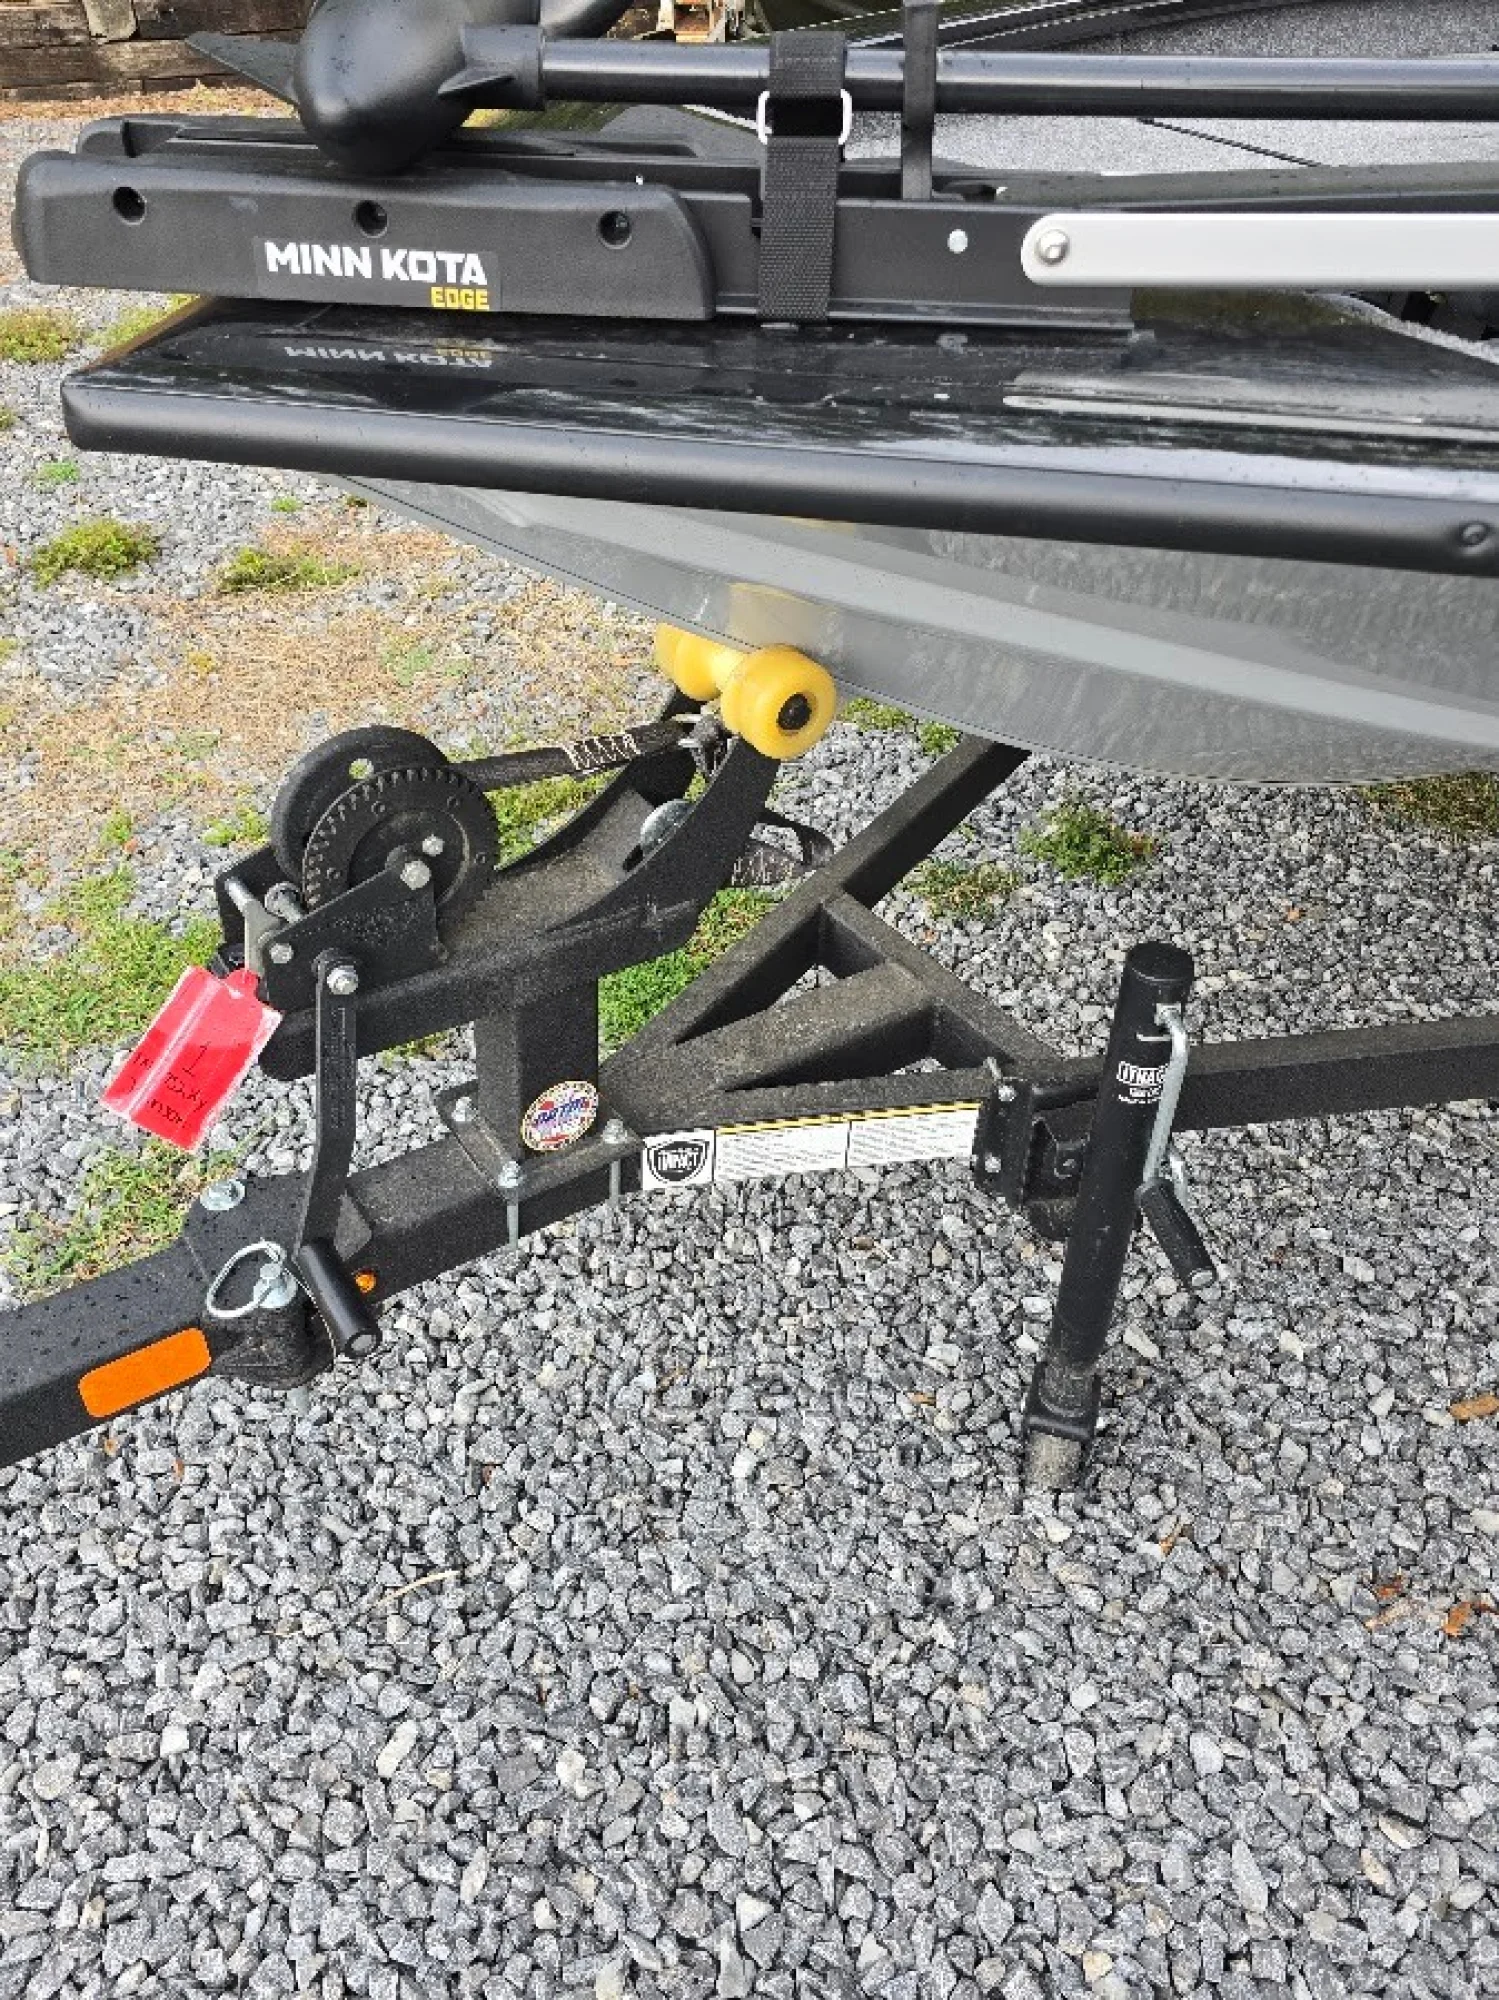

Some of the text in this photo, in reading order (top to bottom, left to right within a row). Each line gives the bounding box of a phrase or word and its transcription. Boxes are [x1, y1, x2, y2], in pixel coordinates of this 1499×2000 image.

[264, 241, 488, 285] MINN KOTA
[430, 286, 490, 310] EDGE
